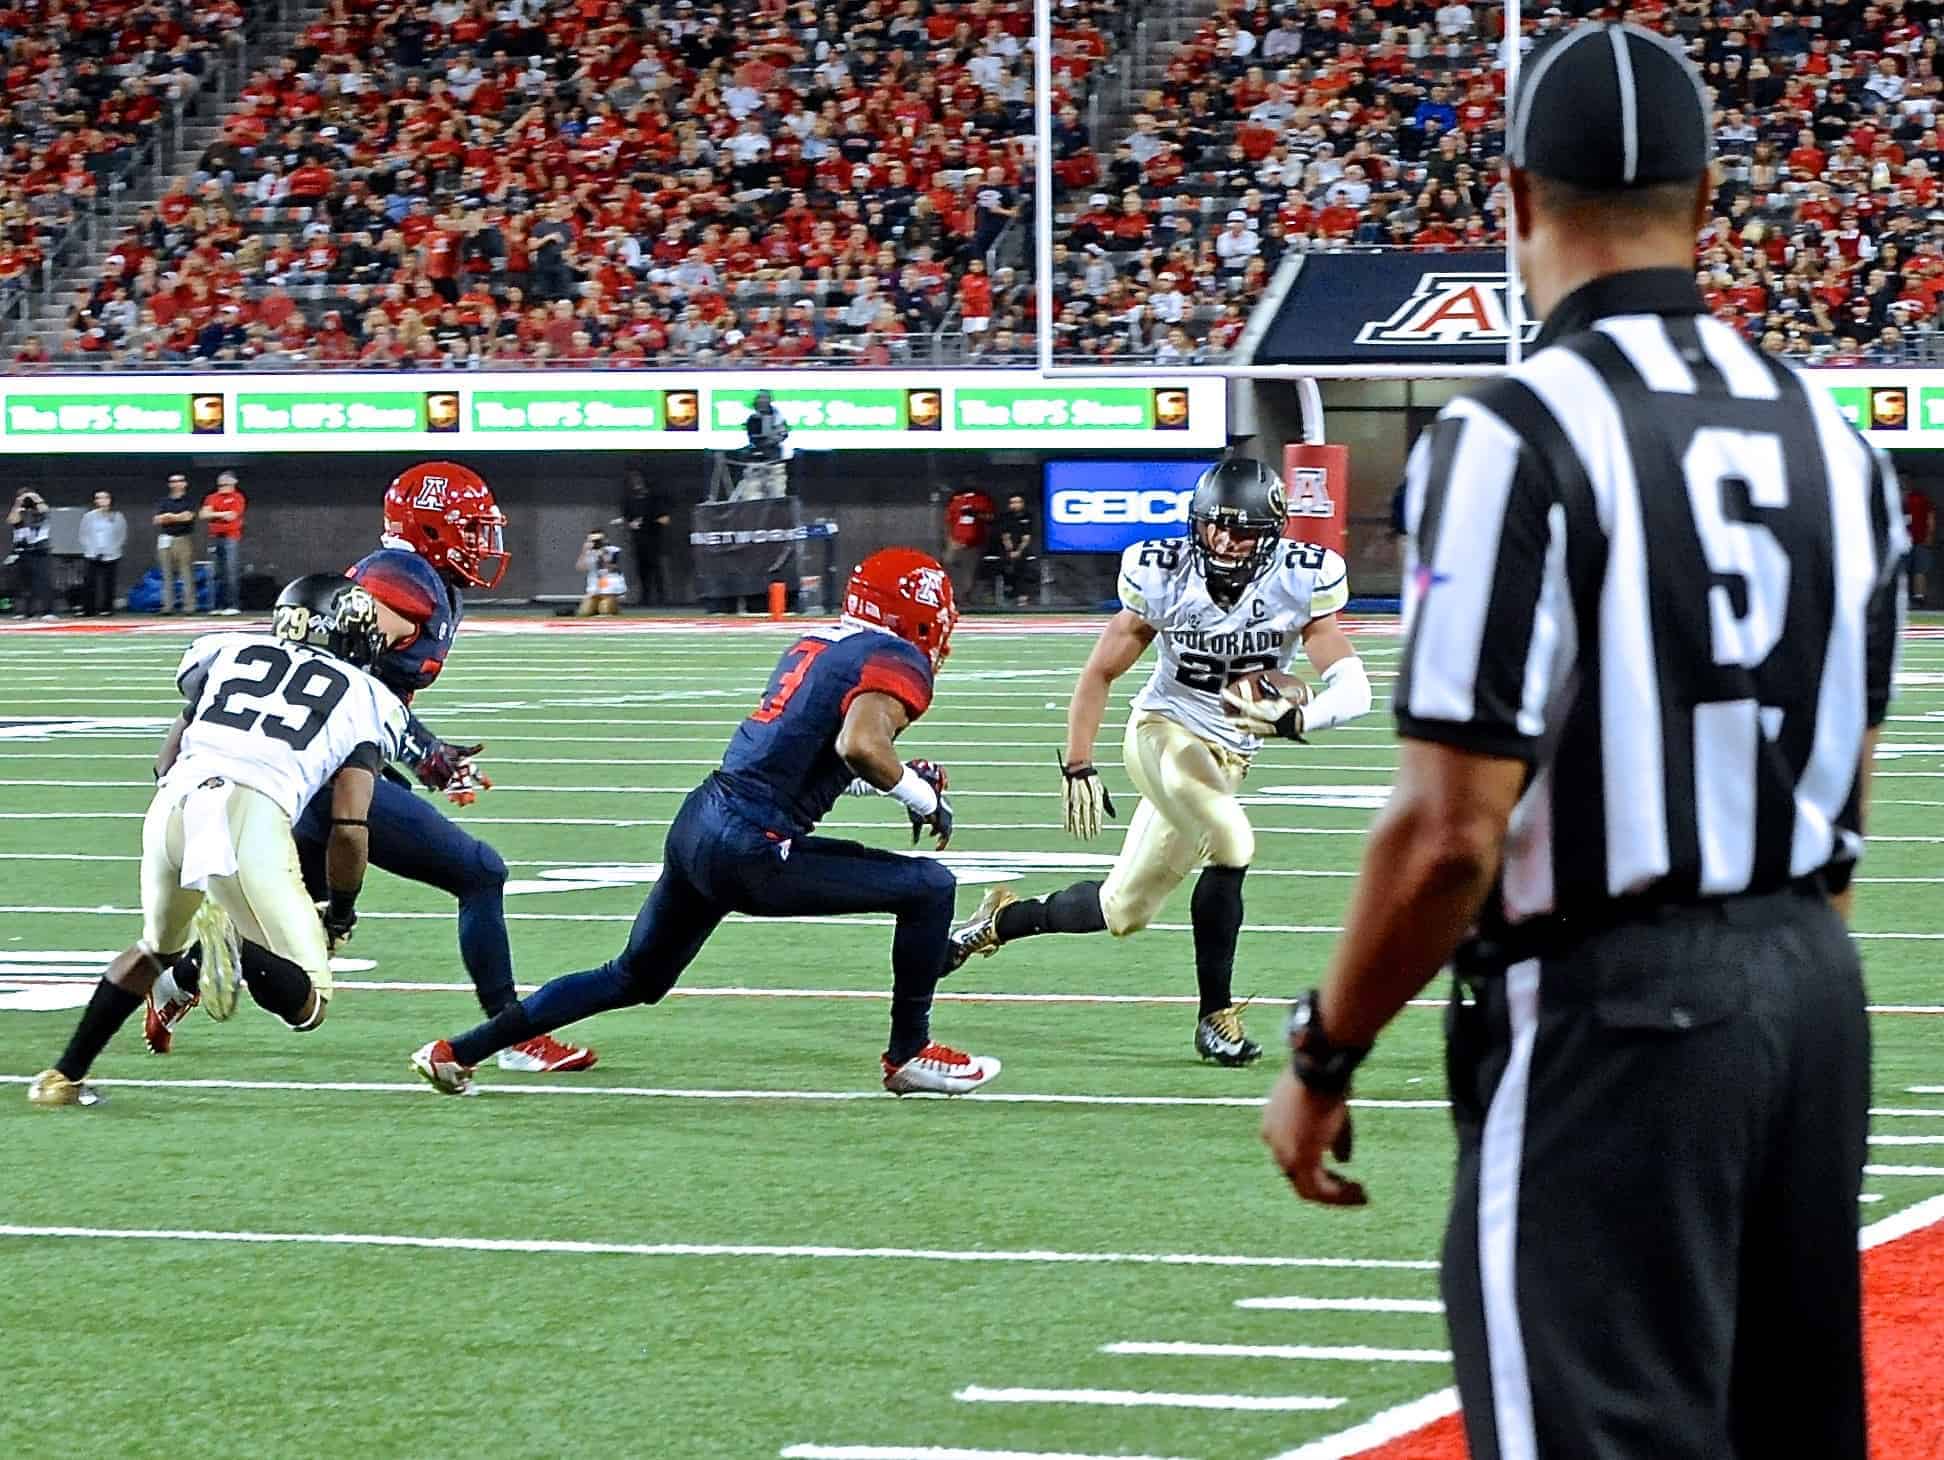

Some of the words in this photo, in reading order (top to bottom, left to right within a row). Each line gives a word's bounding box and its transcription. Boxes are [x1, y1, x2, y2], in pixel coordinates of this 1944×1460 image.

[1354, 273, 1543, 345] A
[413, 475, 449, 511] A
[1286, 467, 1336, 517] A
[1682, 427, 1790, 668] S
[276, 606, 310, 641] 29
[1252, 599, 1265, 618] C
[1171, 630, 1284, 656] COLORADO
[200, 645, 350, 751] 29
[747, 640, 829, 724] 3
